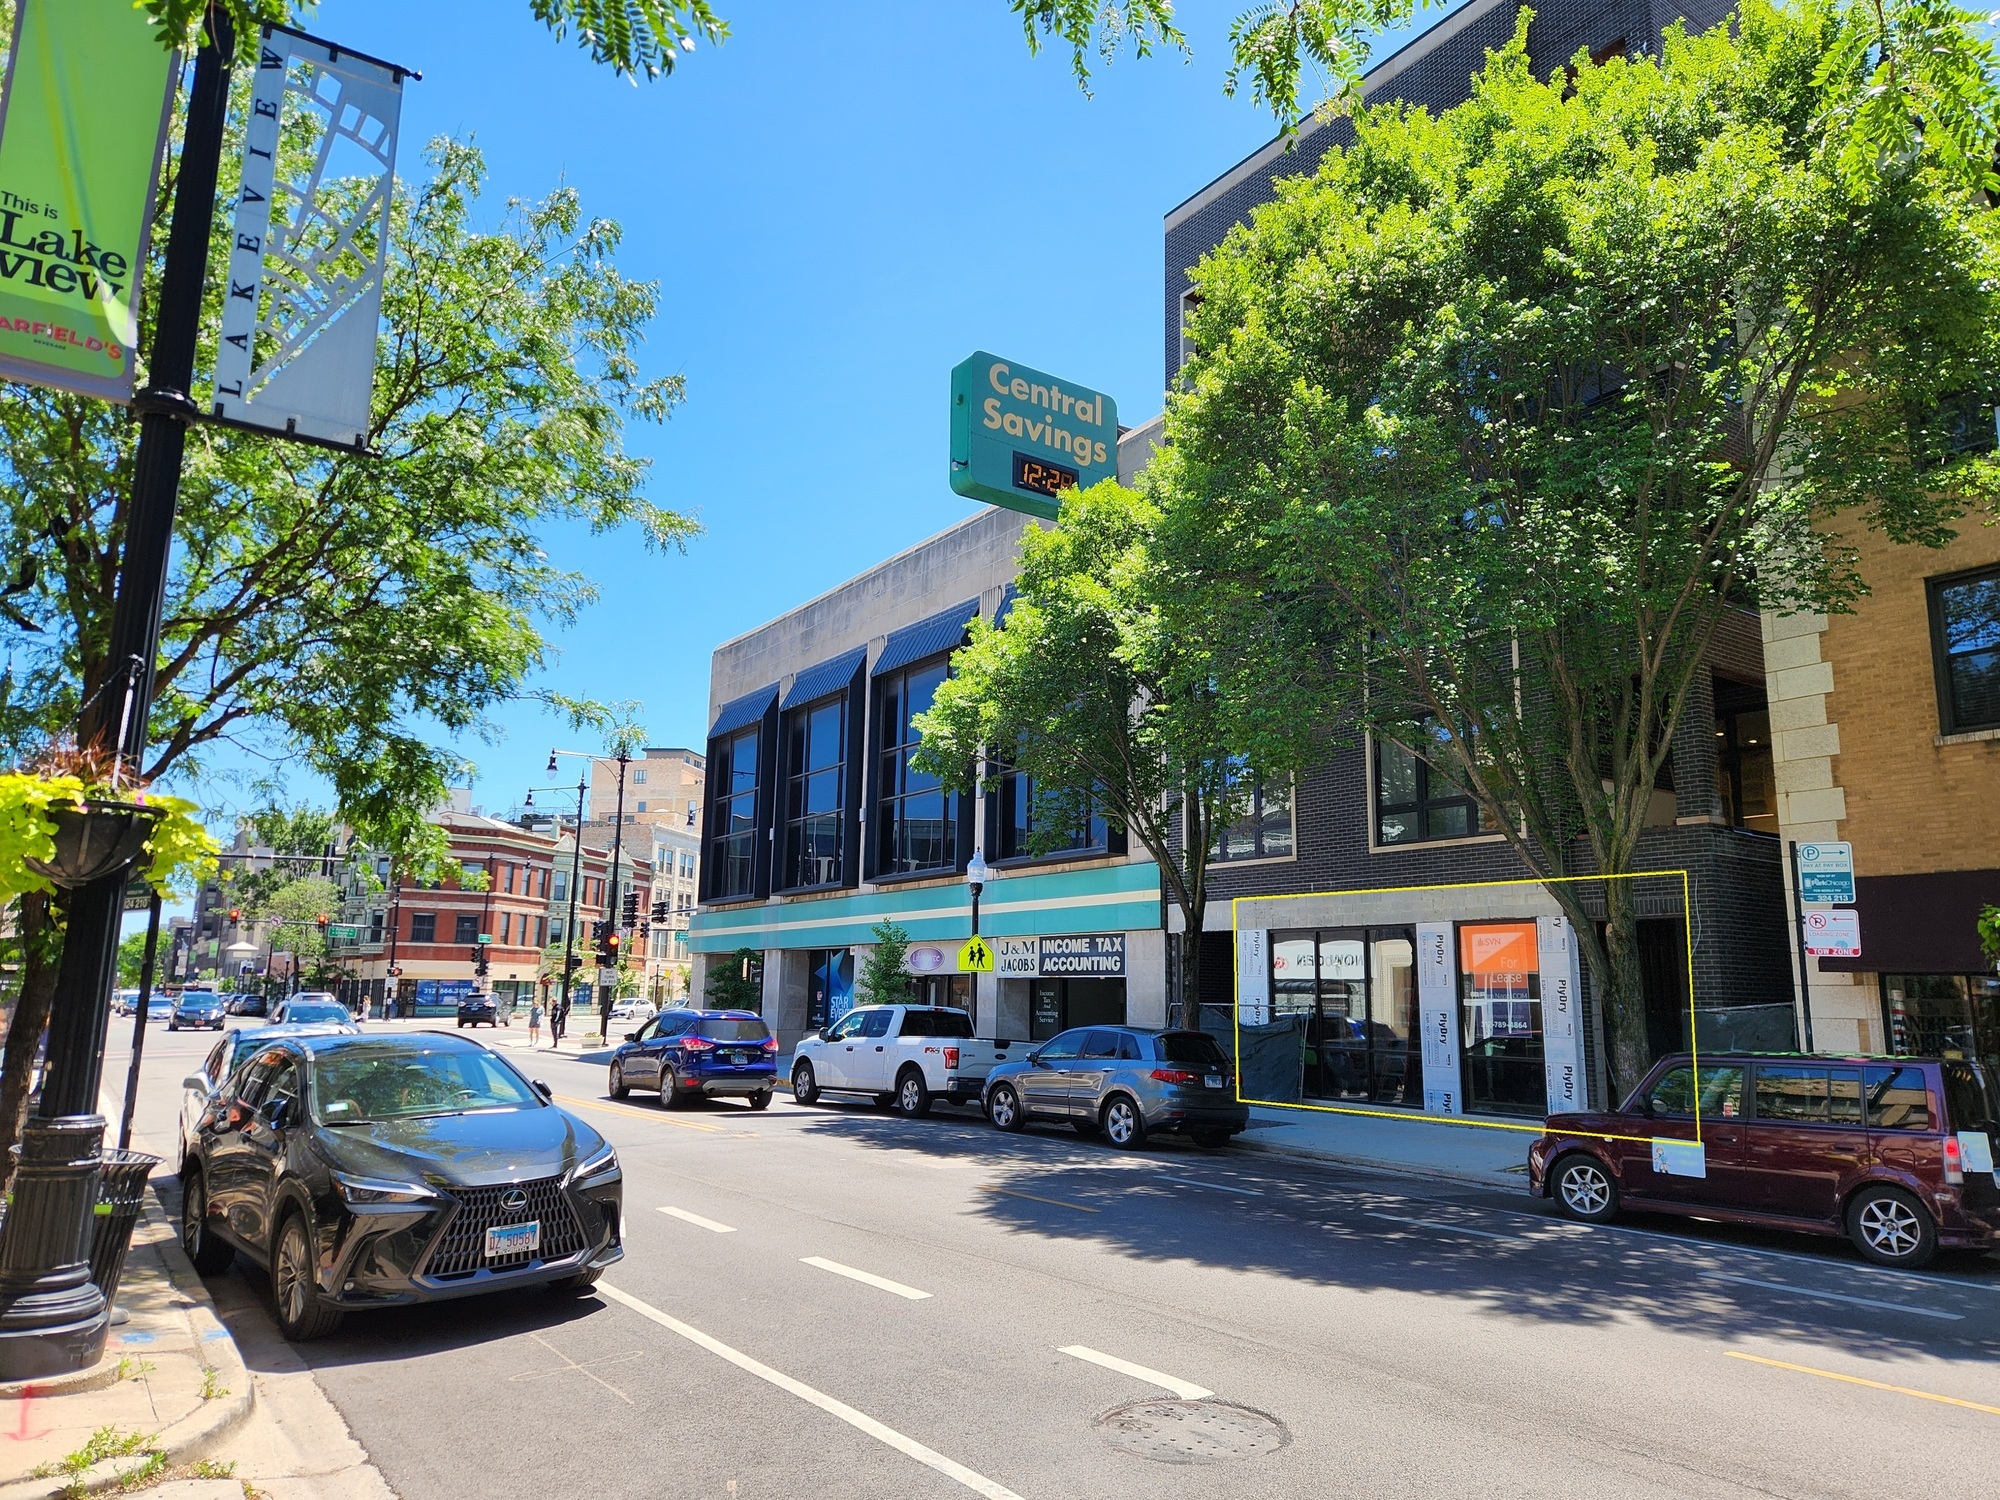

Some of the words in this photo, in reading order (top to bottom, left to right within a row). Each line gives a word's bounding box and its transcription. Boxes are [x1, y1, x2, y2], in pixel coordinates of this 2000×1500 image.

[1, 190, 39, 214] This
[44, 203, 58, 220] is
[218, 45, 283, 399] LAKEVIEW
[0, 208, 127, 278] Lake
[0, 250, 124, 305] view
[0, 316, 123, 360] ARFIELD'S
[989, 363, 1102, 427] Central
[982, 397, 1107, 467] Savings
[1001, 940, 1036, 956] J&M
[1042, 939, 1090, 954] INCOME
[1096, 937, 1123, 953] TAX
[1435, 934, 1445, 966] PlyDry
[1485, 938, 1501, 947] SVN
[1001, 958, 1036, 972] JACOBS
[1042, 956, 1121, 972] ACCOUNTING
[1491, 972, 1522, 983] Lease
[1501, 957, 1518, 969] For
[831, 993, 849, 1009] STAR
[1557, 979, 1568, 1014] PlyDry
[1035, 1009, 1059, 1018] Accounting
[1438, 1013, 1448, 1045] PlyDry
[1562, 1066, 1574, 1101] PlyDry
[489, 1236, 502, 1250] DZ
[506, 1231, 537, 1248] 50587
